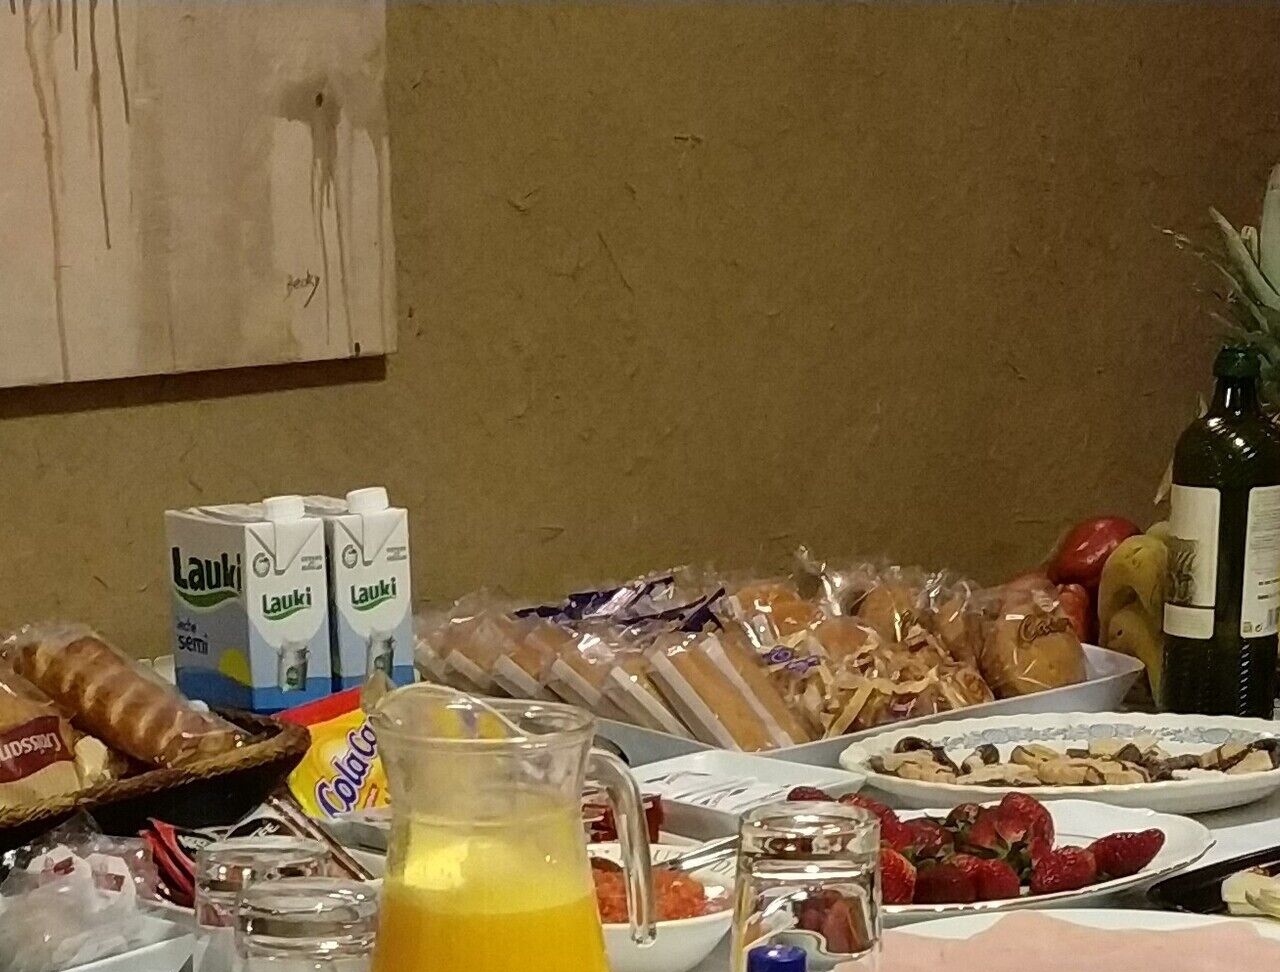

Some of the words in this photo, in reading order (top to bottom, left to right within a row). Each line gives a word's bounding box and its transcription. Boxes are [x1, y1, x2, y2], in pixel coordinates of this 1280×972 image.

[172, 547, 242, 593] Lauki
[262, 587, 312, 614] Lauki
[350, 577, 397, 605] Lauki
